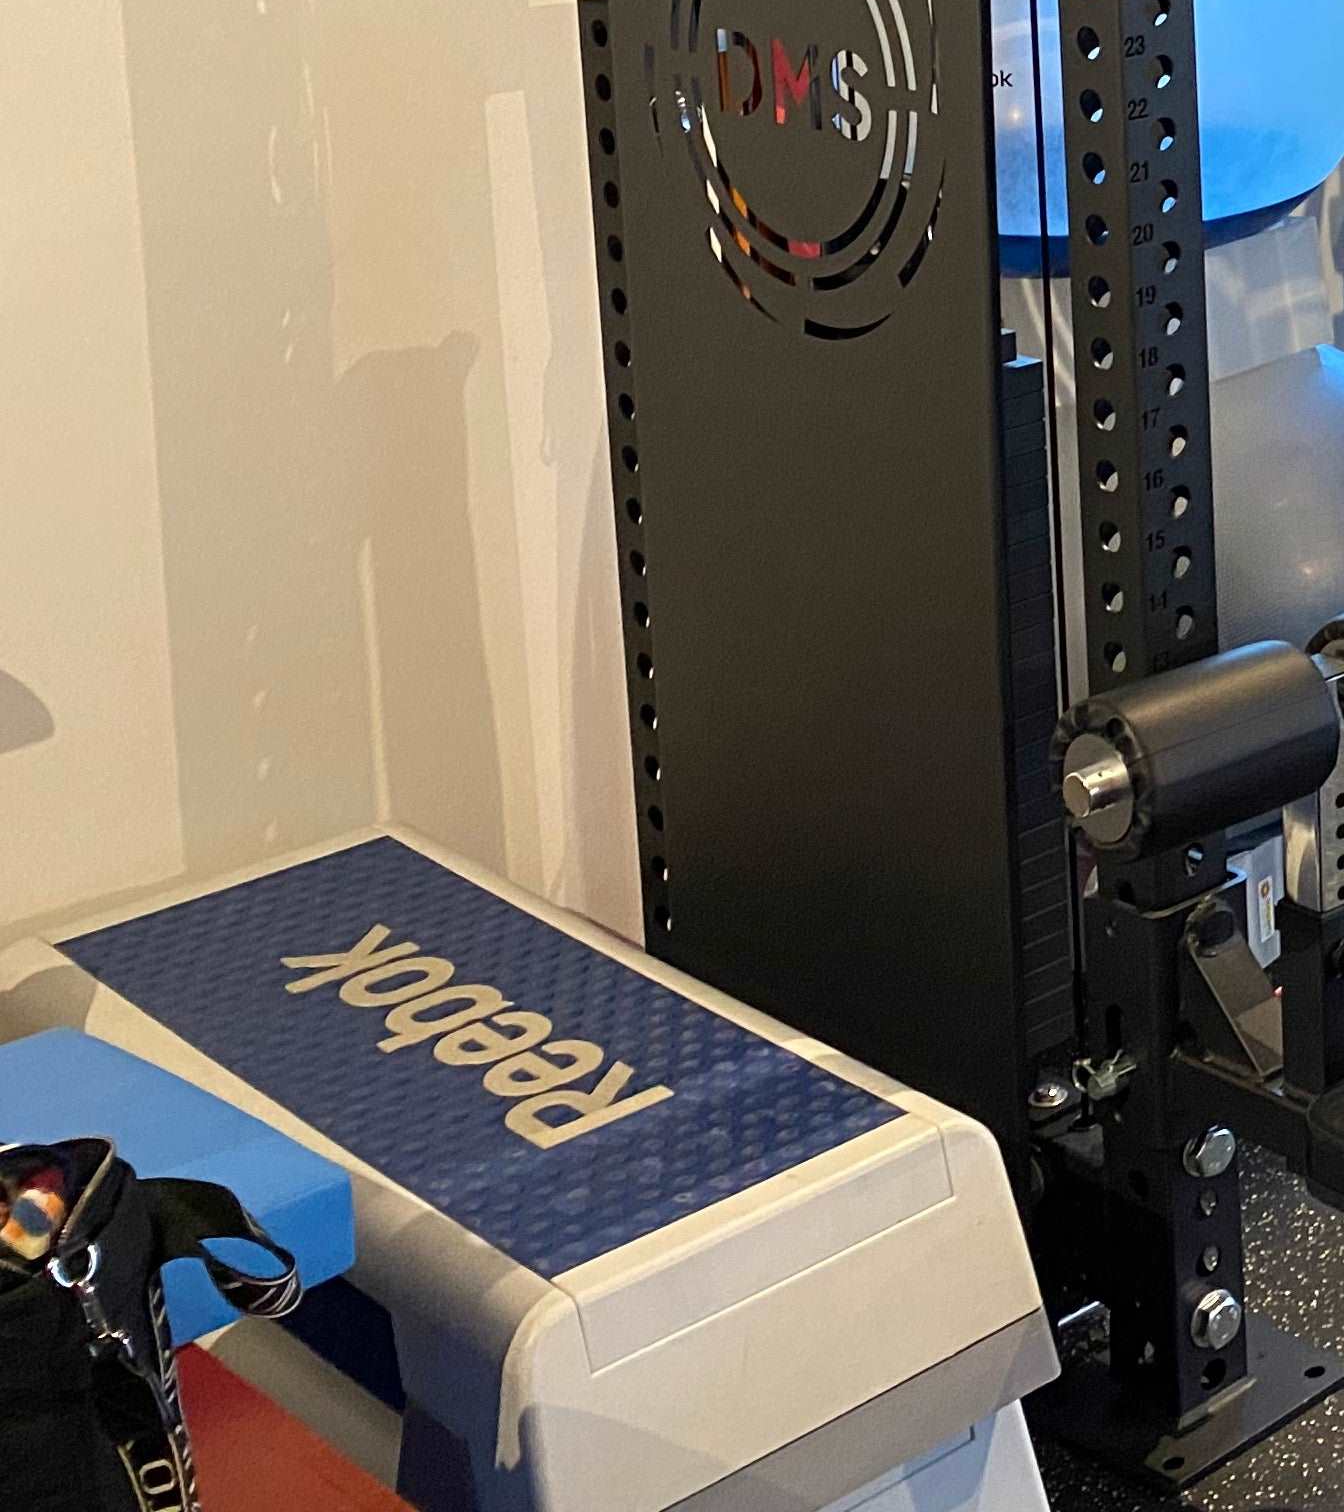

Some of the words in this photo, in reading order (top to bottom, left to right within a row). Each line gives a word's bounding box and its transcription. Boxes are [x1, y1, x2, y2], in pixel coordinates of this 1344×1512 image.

[1124, 36, 1145, 57] 23
[716, 28, 872, 141] DMS
[1127, 99, 1148, 119] 22
[1130, 162, 1150, 182] 21
[1132, 223, 1153, 243] 20
[1135, 287, 1156, 307] 19
[1138, 347, 1158, 367] 18
[1141, 408, 1161, 428] 17
[1144, 470, 1164, 490] 16
[1146, 531, 1166, 551] 15
[280, 924, 674, 1149] Reebok
